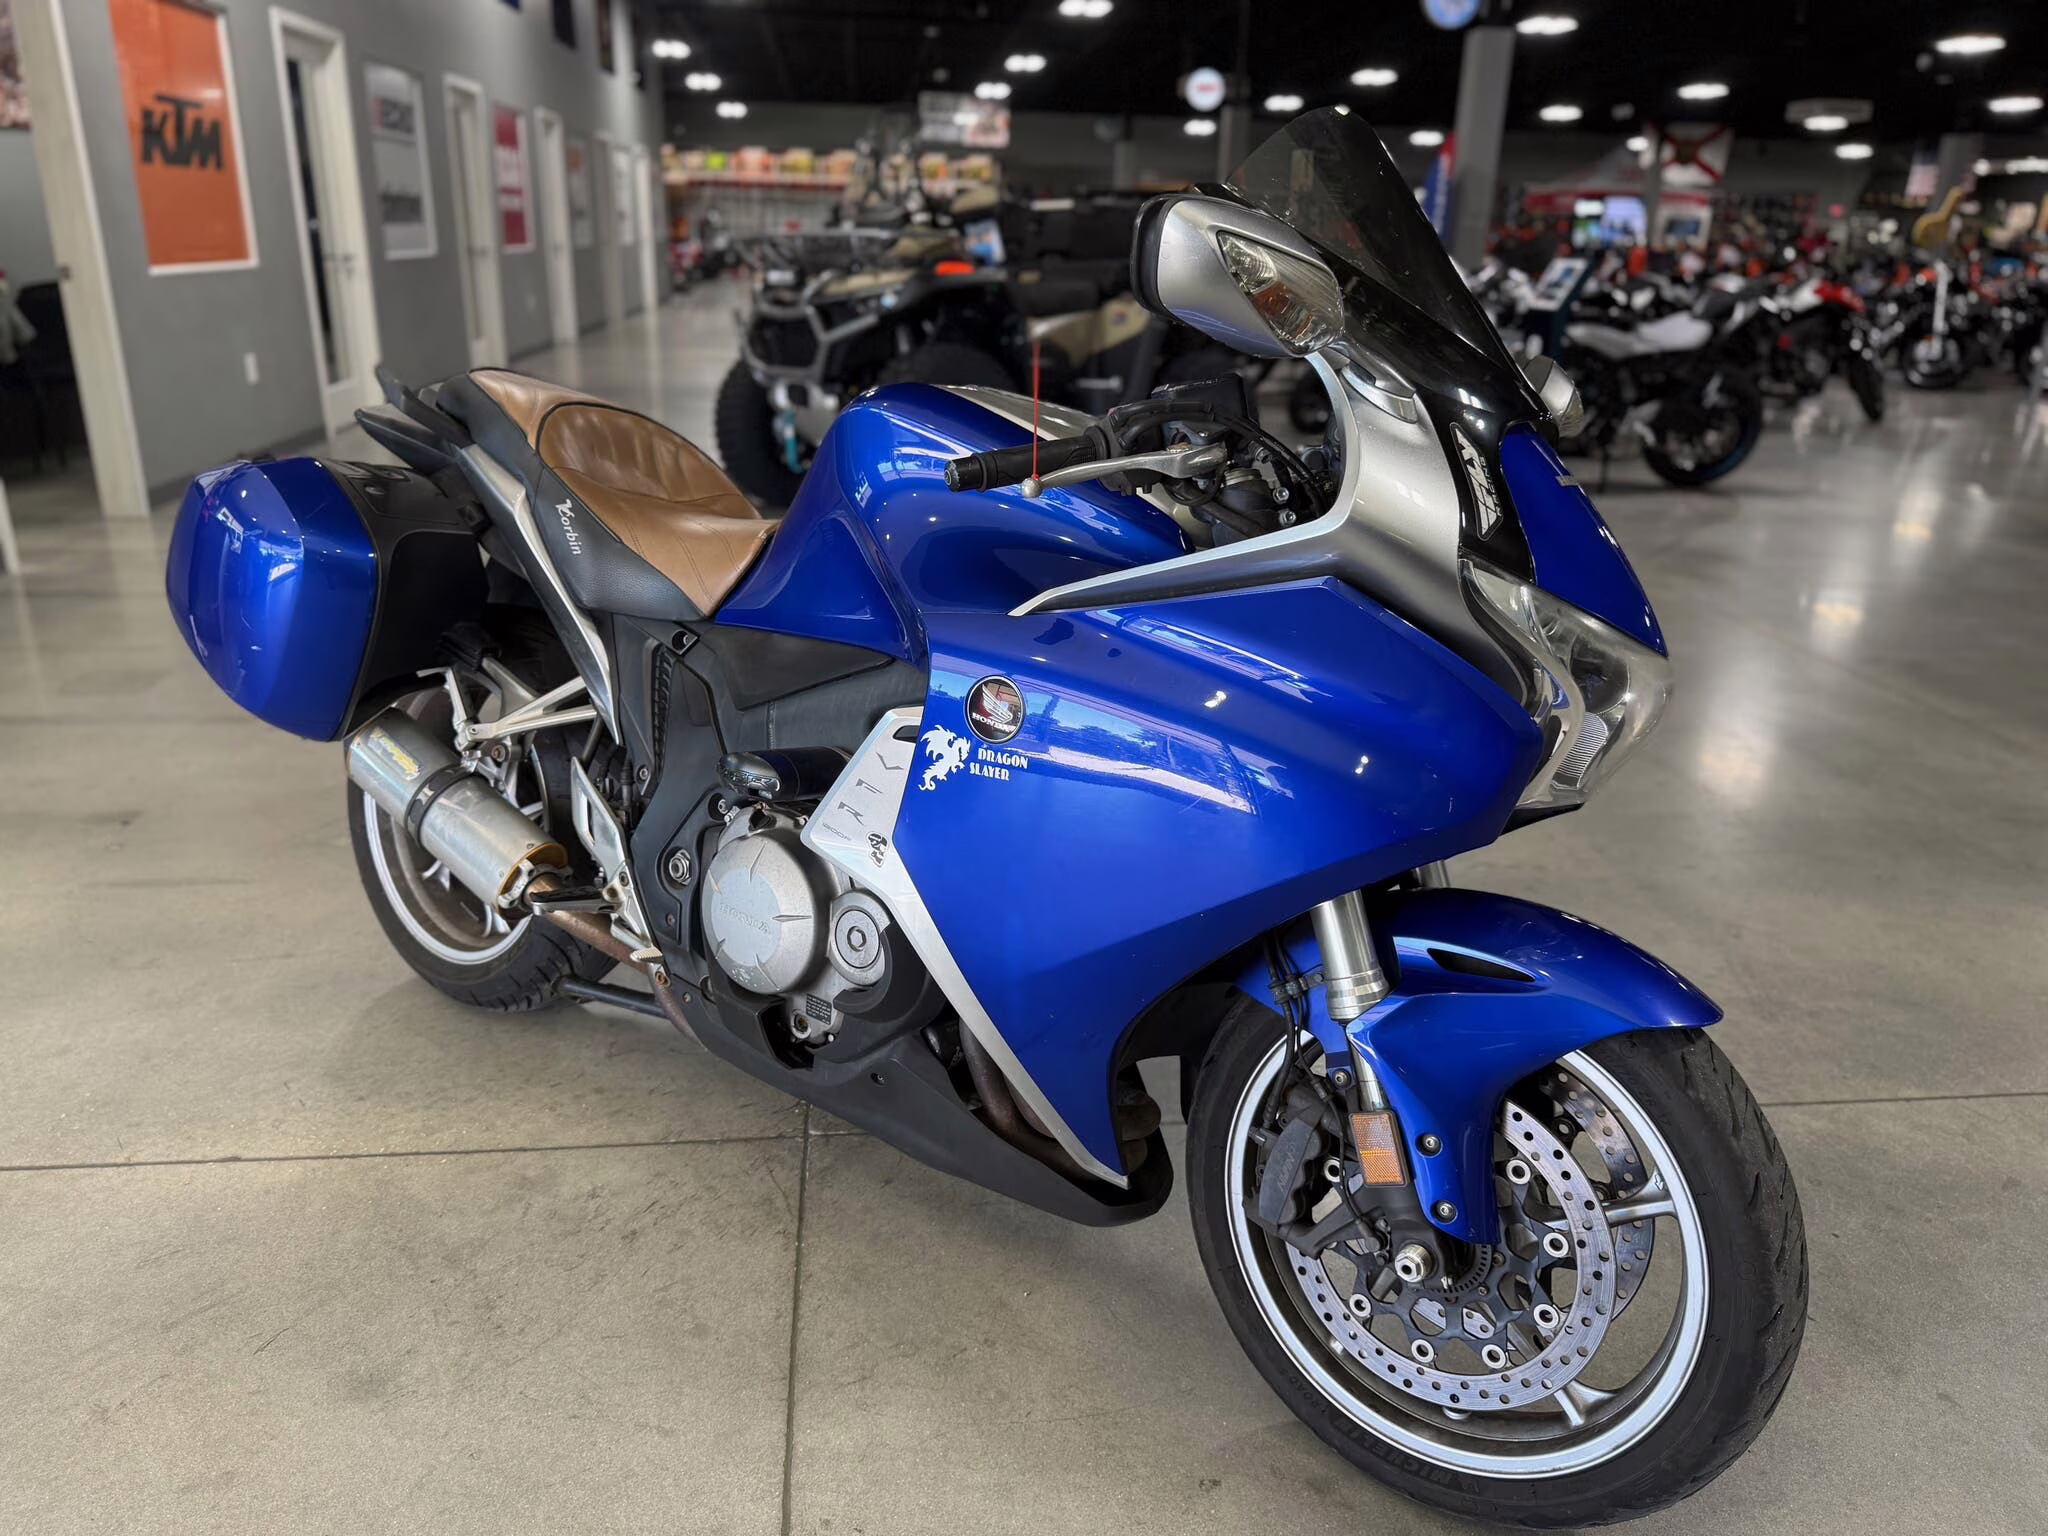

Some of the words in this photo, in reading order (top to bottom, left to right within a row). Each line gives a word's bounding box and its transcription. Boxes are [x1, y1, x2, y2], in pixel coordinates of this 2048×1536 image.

[142, 94, 223, 171] KTM
[555, 498, 582, 555] Korbin
[972, 712, 1017, 732] HONDA
[970, 762, 1009, 780] SLAYER
[978, 748, 1028, 769] DRAGON
[1332, 1414, 1451, 1484] MICHELIN
